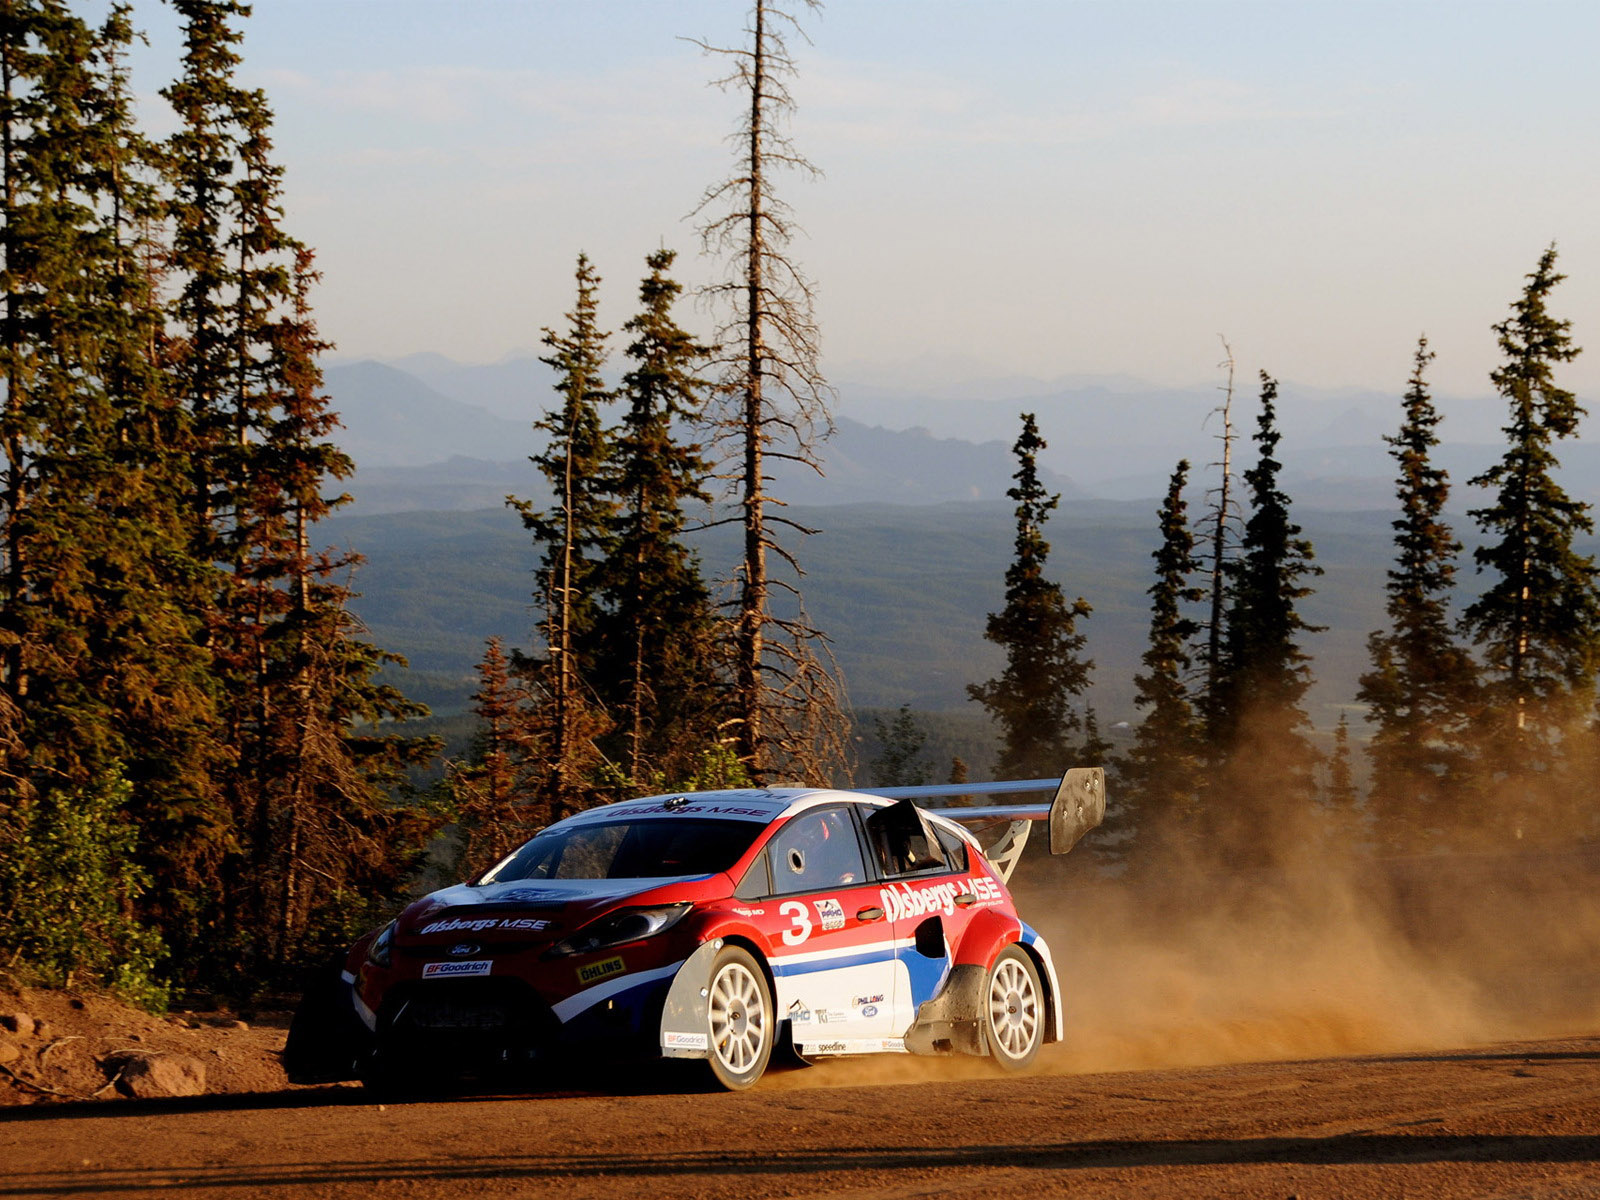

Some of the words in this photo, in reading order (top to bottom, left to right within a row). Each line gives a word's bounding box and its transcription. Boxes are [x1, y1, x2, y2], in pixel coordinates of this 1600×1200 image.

[707, 805, 772, 817] MSE
[880, 881, 958, 923] Olsbergs
[957, 876, 1002, 901] MSE
[420, 918, 499, 935] Olsbergs
[498, 918, 547, 930] MSE
[779, 900, 812, 946] 3
[426, 962, 488, 973] BFGoodrich
[580, 959, 622, 981] ÖHLINS
[667, 1035, 705, 1044] BFGoodrich
[818, 1041, 846, 1054] speedline
